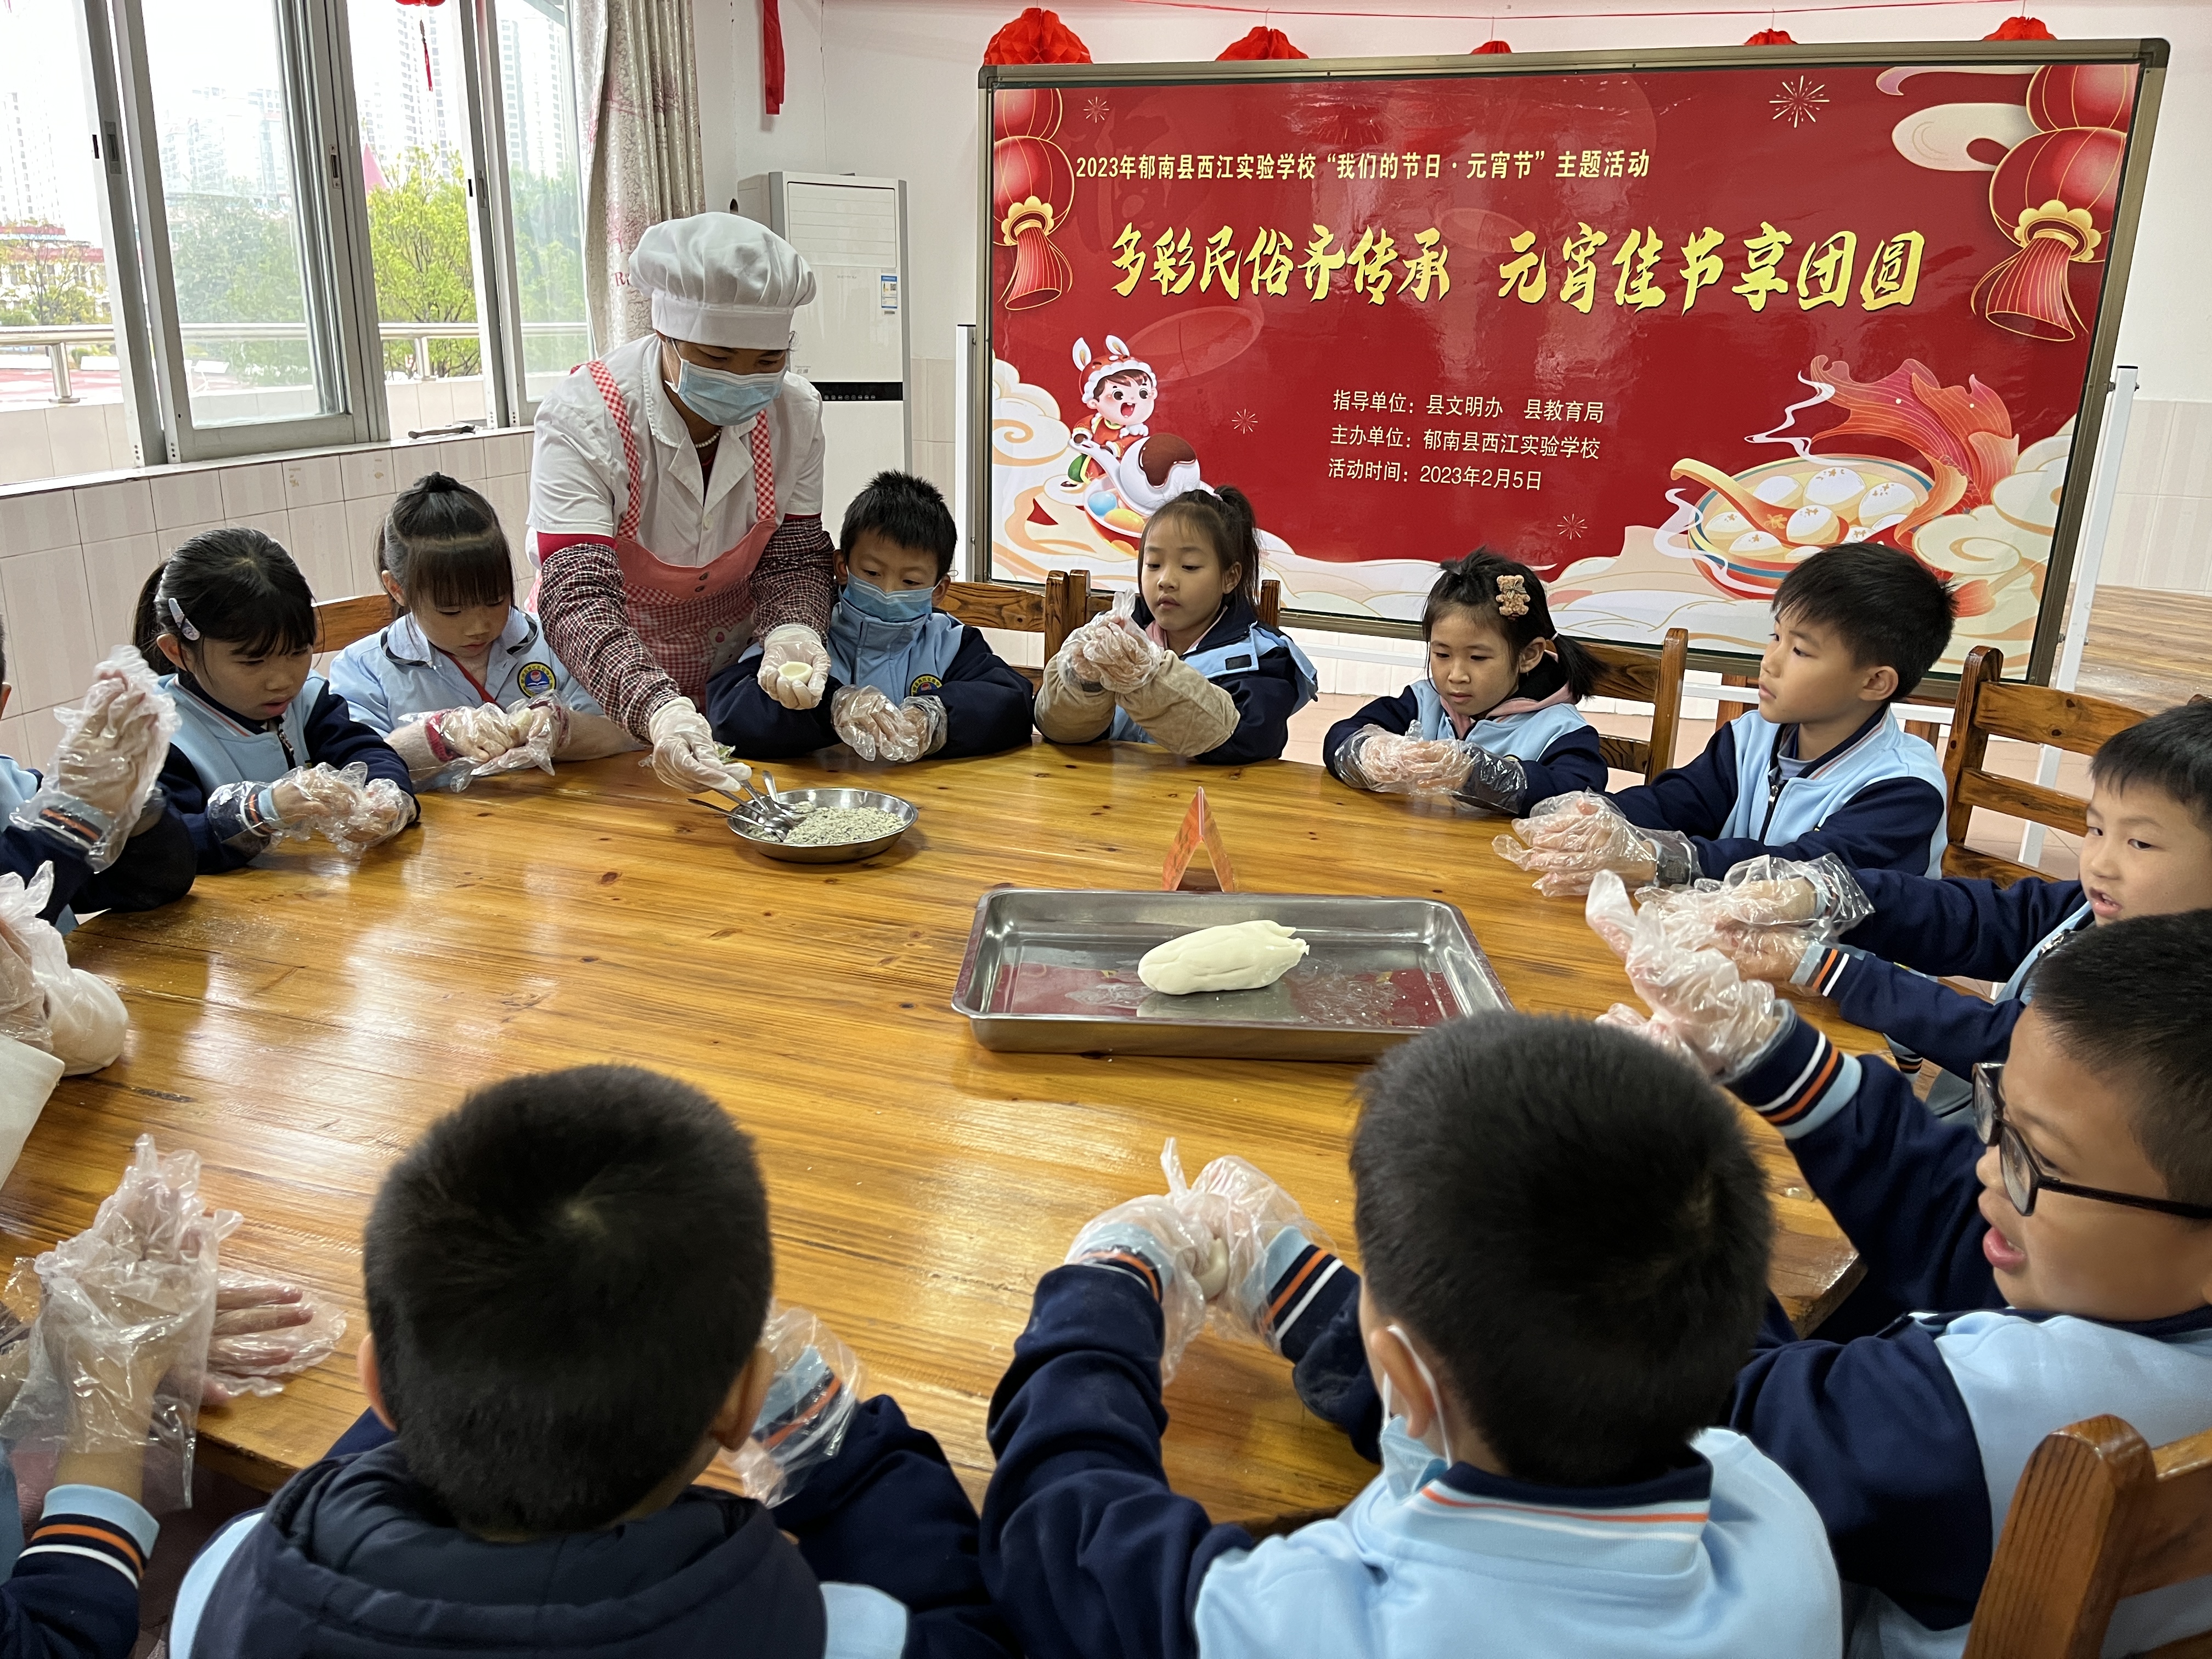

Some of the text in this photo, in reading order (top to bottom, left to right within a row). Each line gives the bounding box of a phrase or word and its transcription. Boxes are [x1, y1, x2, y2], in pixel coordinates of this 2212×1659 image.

[1111, 221, 1925, 315] 多彩民俗齐传承 元宵佳节享团圆
[1523, 399, 1604, 424] 县教育局
